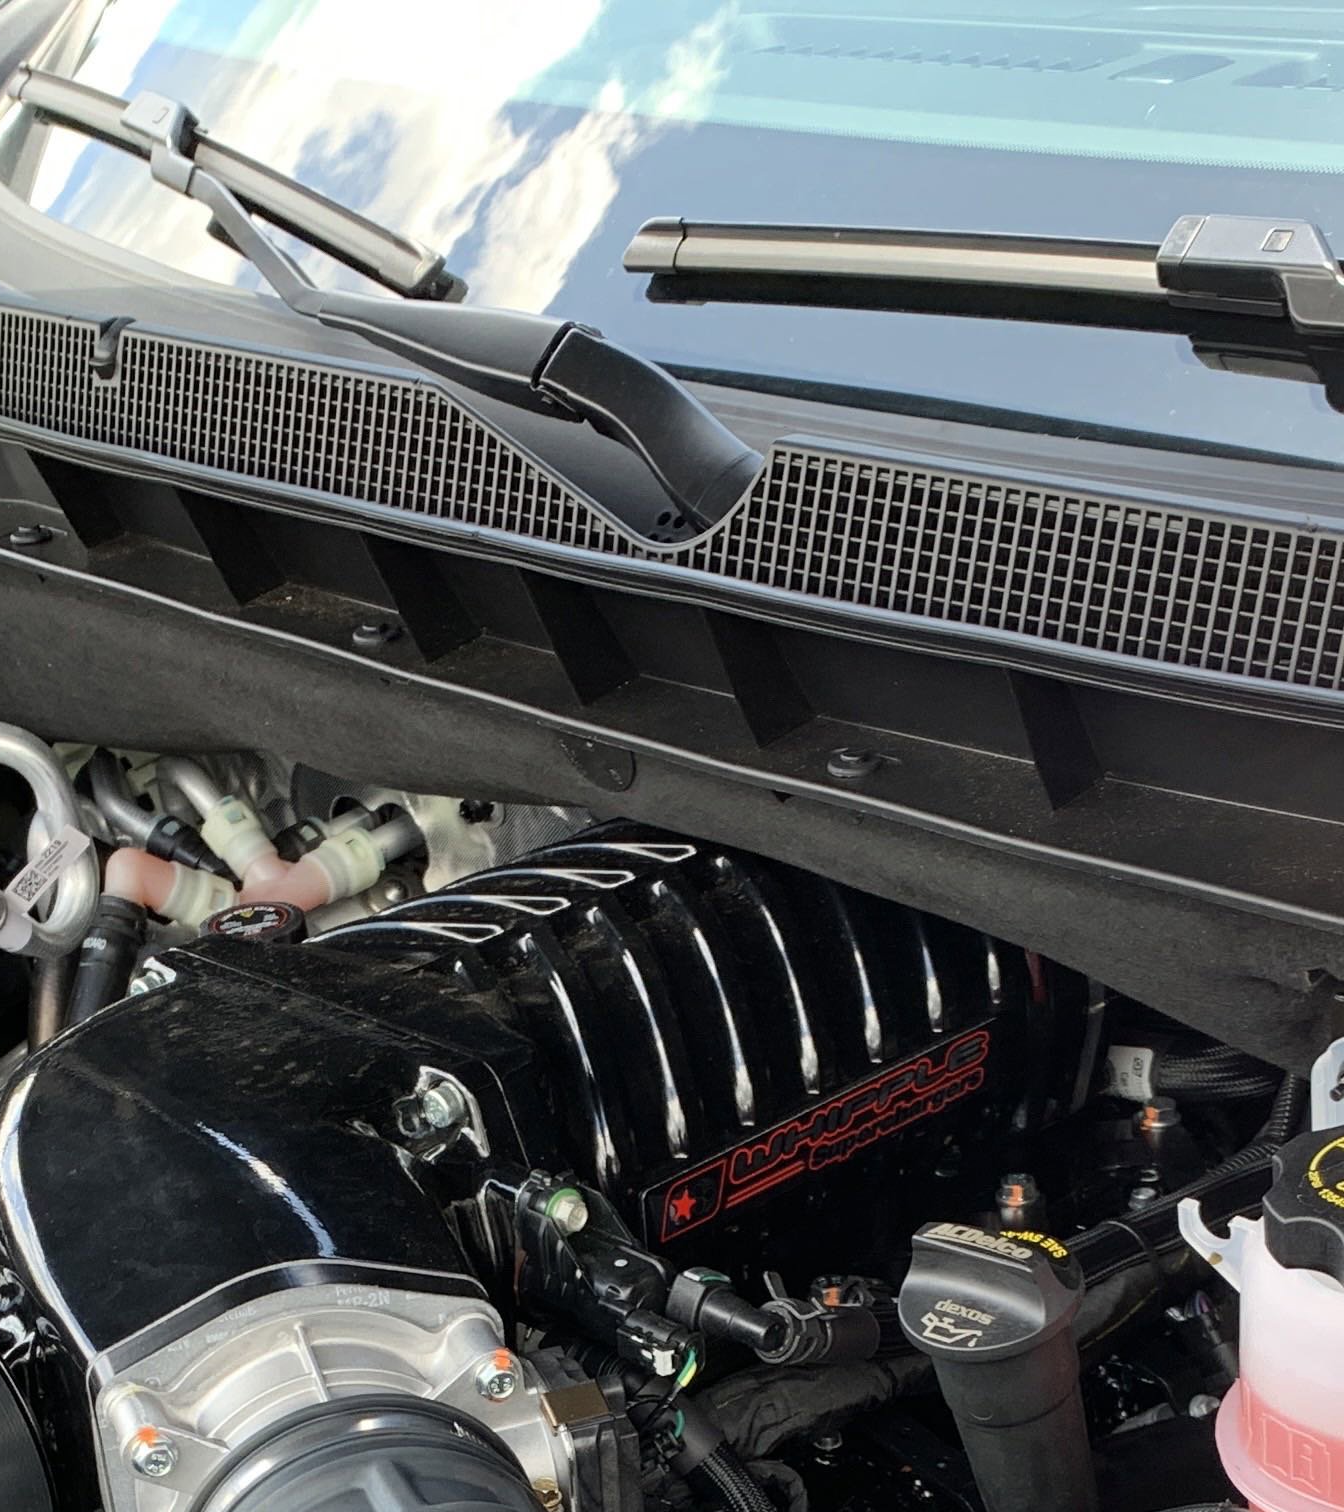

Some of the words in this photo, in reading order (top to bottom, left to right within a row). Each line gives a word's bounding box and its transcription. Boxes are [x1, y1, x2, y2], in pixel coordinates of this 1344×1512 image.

[730, 1031, 990, 1184] WHIPPLE
[809, 1067, 985, 1170] Superchargers
[927, 1223, 1033, 1259] ACDelco
[1040, 1238, 1067, 1258] SAE
[935, 1298, 996, 1326] dexos
